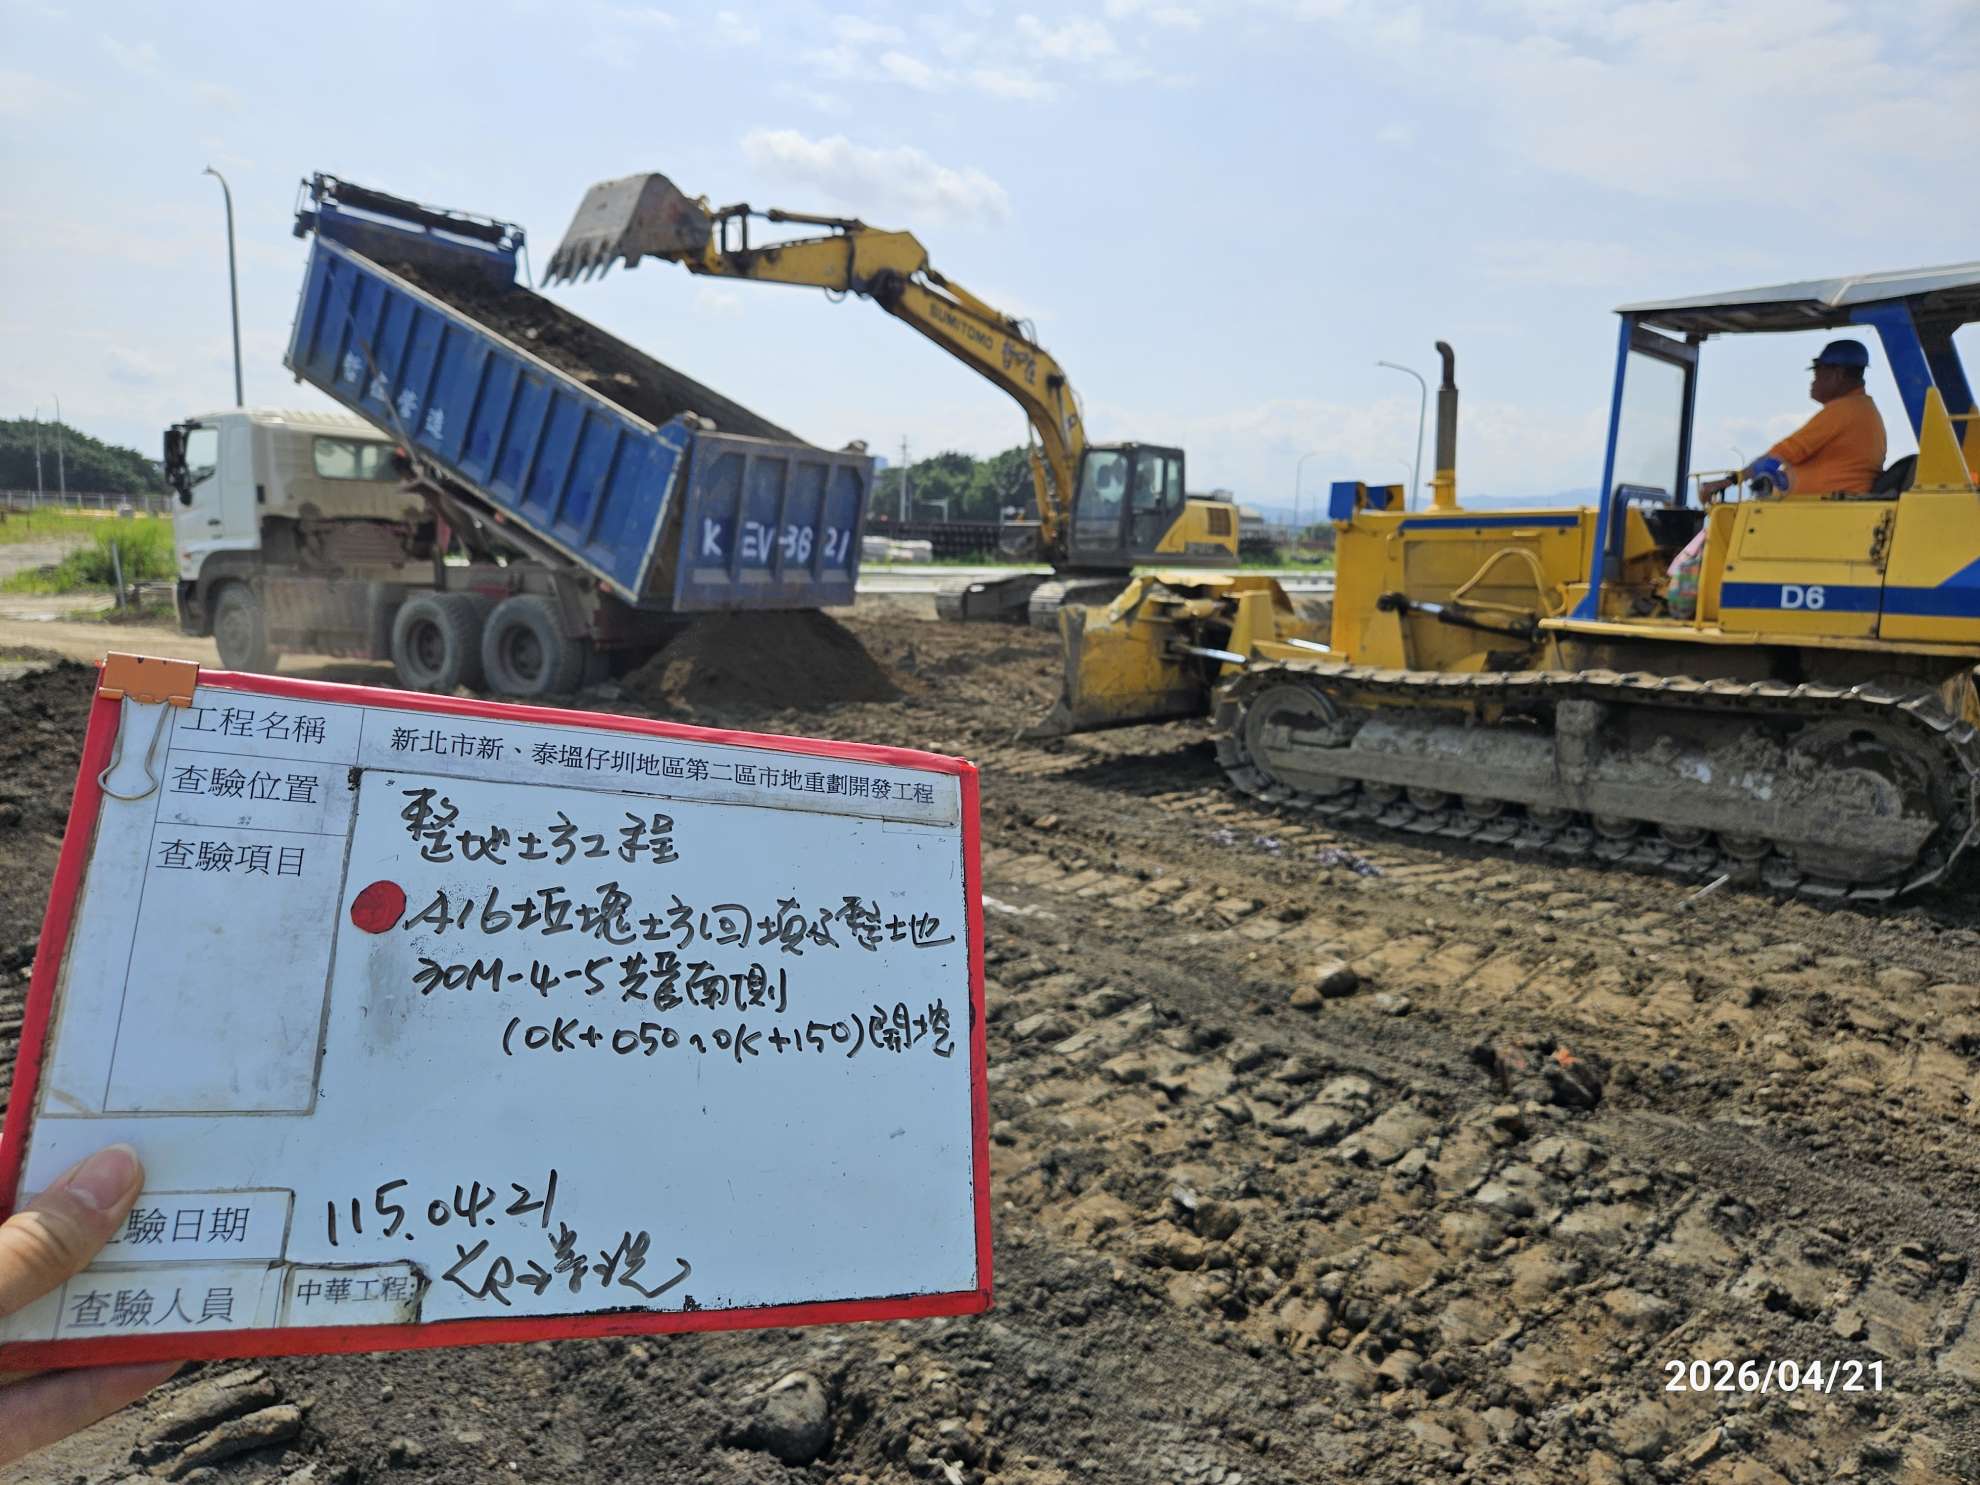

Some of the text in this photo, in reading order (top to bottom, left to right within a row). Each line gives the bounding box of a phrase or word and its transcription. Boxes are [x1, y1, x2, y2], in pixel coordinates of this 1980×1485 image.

[929, 303, 994, 351] SUMITOMO
[1781, 585, 1824, 610] D6
[180, 706, 327, 744] 工程名稱
[169, 764, 319, 804] 查驗位置
[391, 726, 935, 804] 新北市新、泰塭仔圳地區第二區市地重劃開發工程
[155, 838, 305, 877] 查驗項目
[104, 1207, 250, 1245] 驗日期
[327, 1168, 557, 1247] 115.04.21
[64, 1286, 235, 1328] 查驗人員
